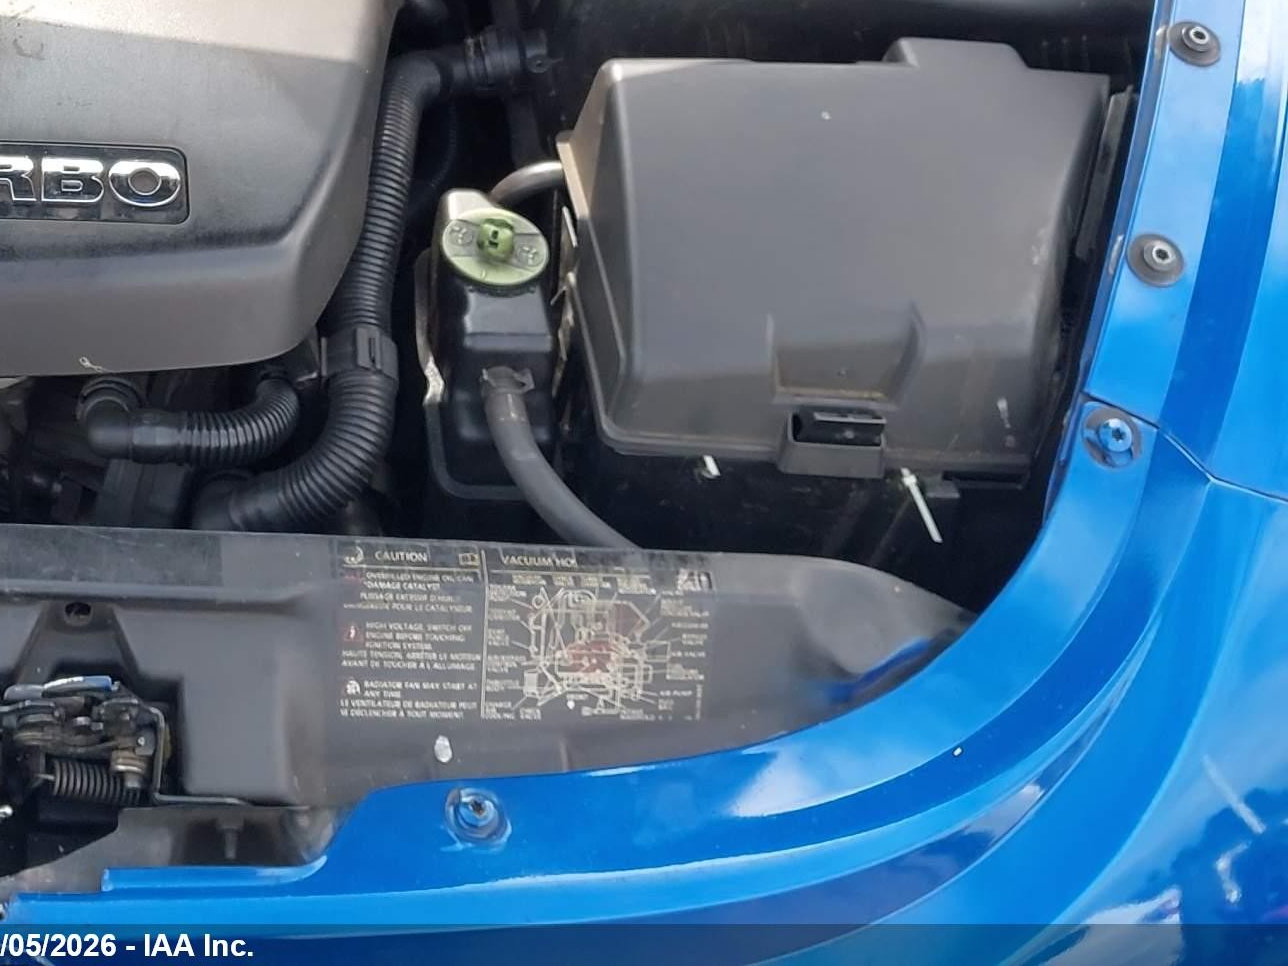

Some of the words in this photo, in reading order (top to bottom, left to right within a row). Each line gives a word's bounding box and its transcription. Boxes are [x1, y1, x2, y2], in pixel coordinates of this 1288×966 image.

[374, 550, 428, 562] CAUTION
[502, 554, 553, 566] VACUUM
[402, 582, 440, 591] CATALYST
[396, 632, 422, 640] BEFORE
[366, 642, 401, 650] IGNITION
[341, 660, 368, 668] AVANT
[364, 680, 402, 690] RADIATOR
[404, 681, 420, 690] FAN
[422, 682, 440, 690] MAY
[442, 682, 464, 690] START
[364, 690, 380, 698] ANY
